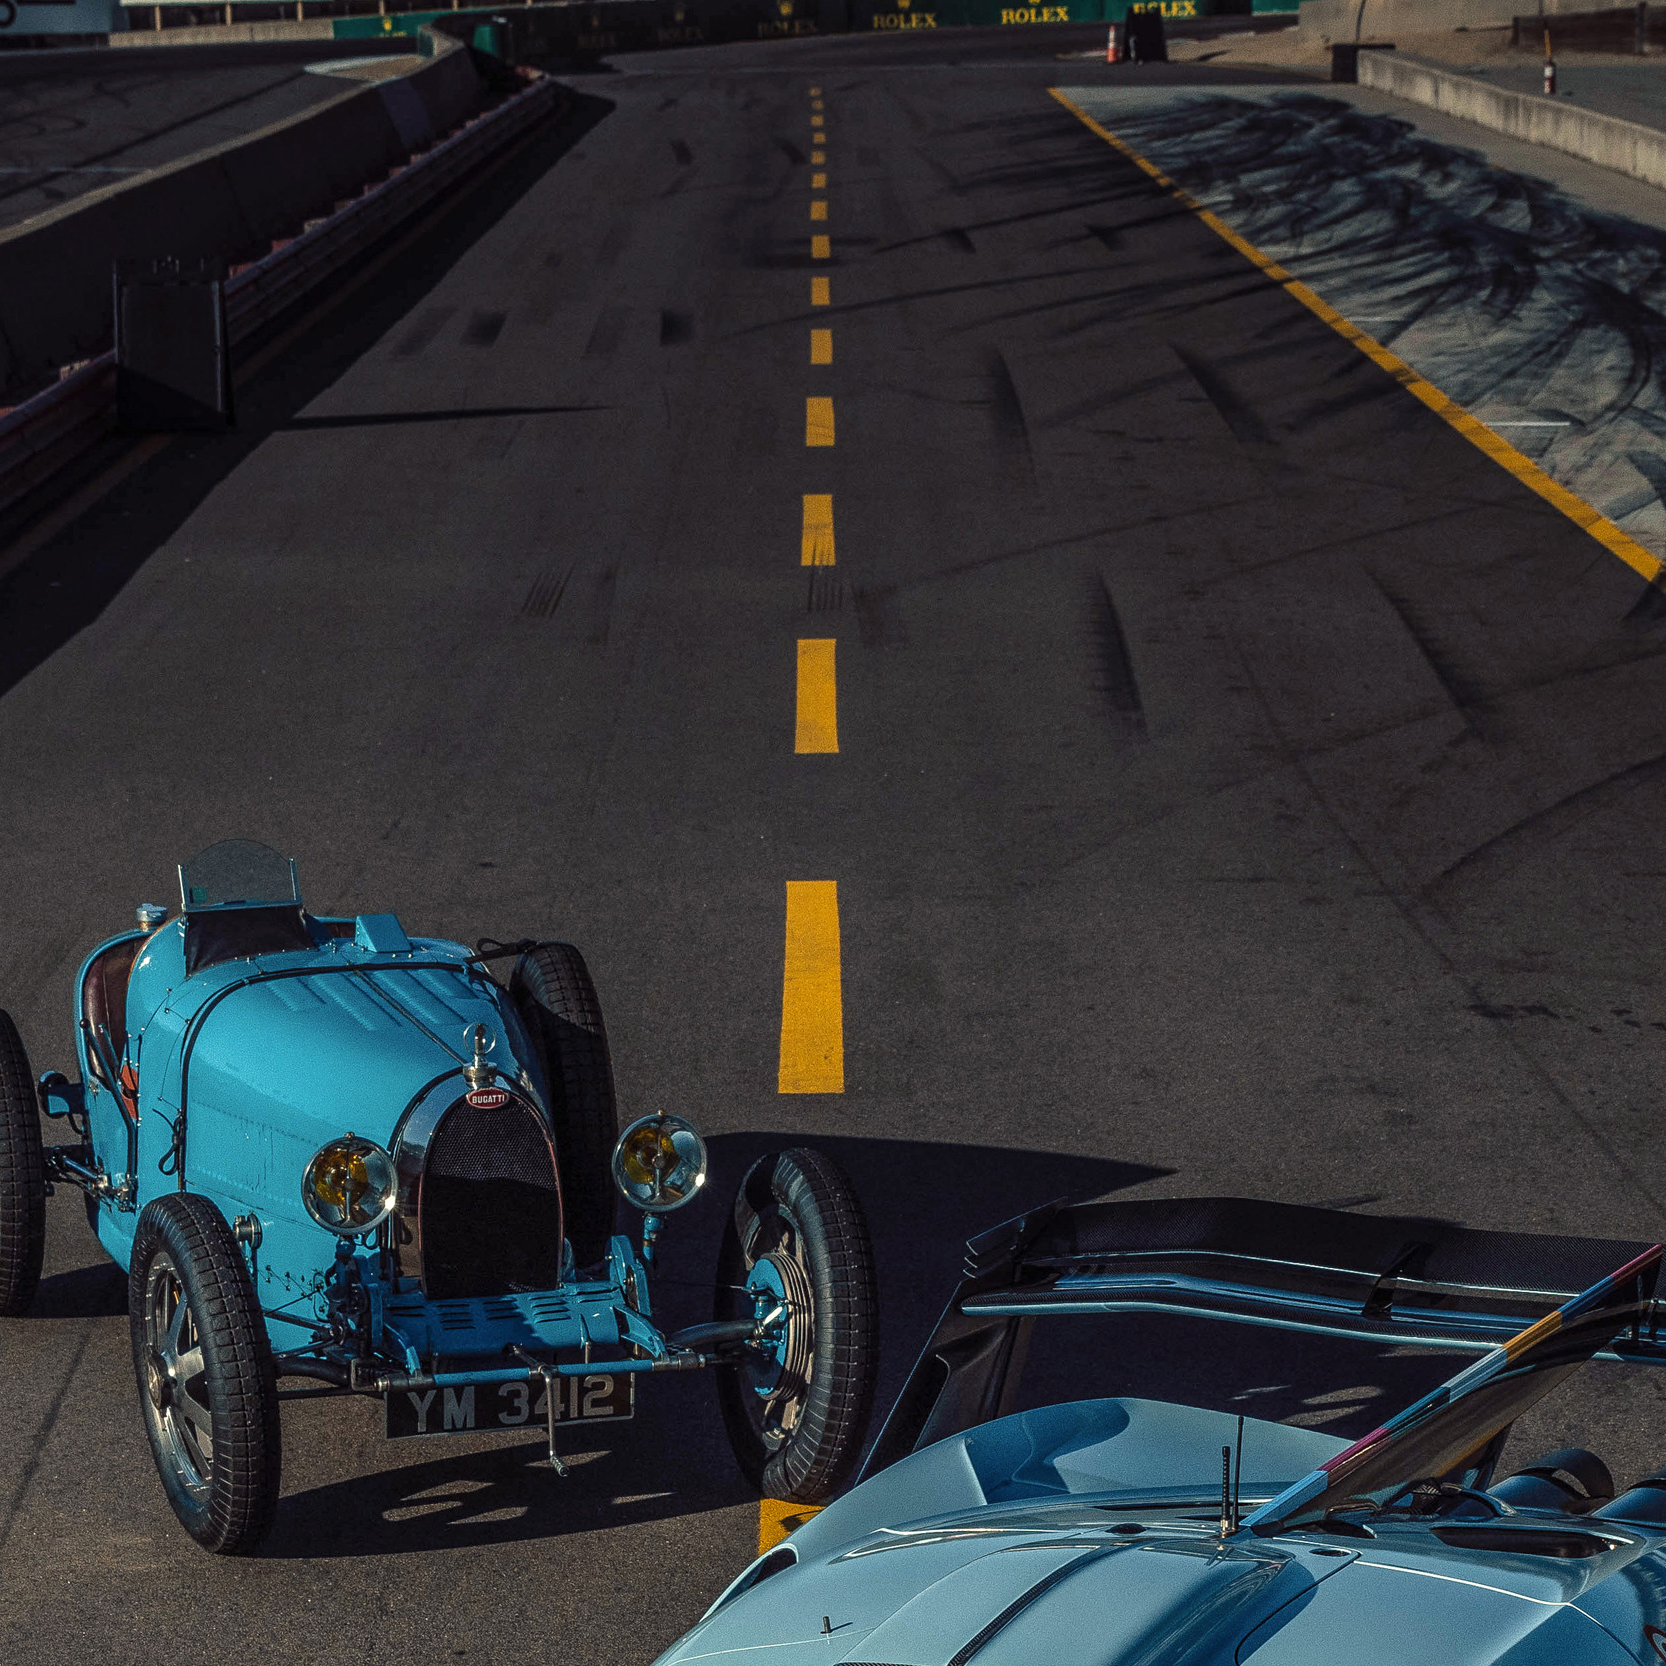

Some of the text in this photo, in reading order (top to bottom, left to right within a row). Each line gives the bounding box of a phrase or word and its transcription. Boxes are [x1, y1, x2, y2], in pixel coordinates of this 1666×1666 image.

[873, 12, 937, 29] ROLEX
[1001, 6, 1069, 24] ROLEX
[472, 1094, 505, 1104] BUGATTI
[407, 1374, 614, 1432] YM 3412
